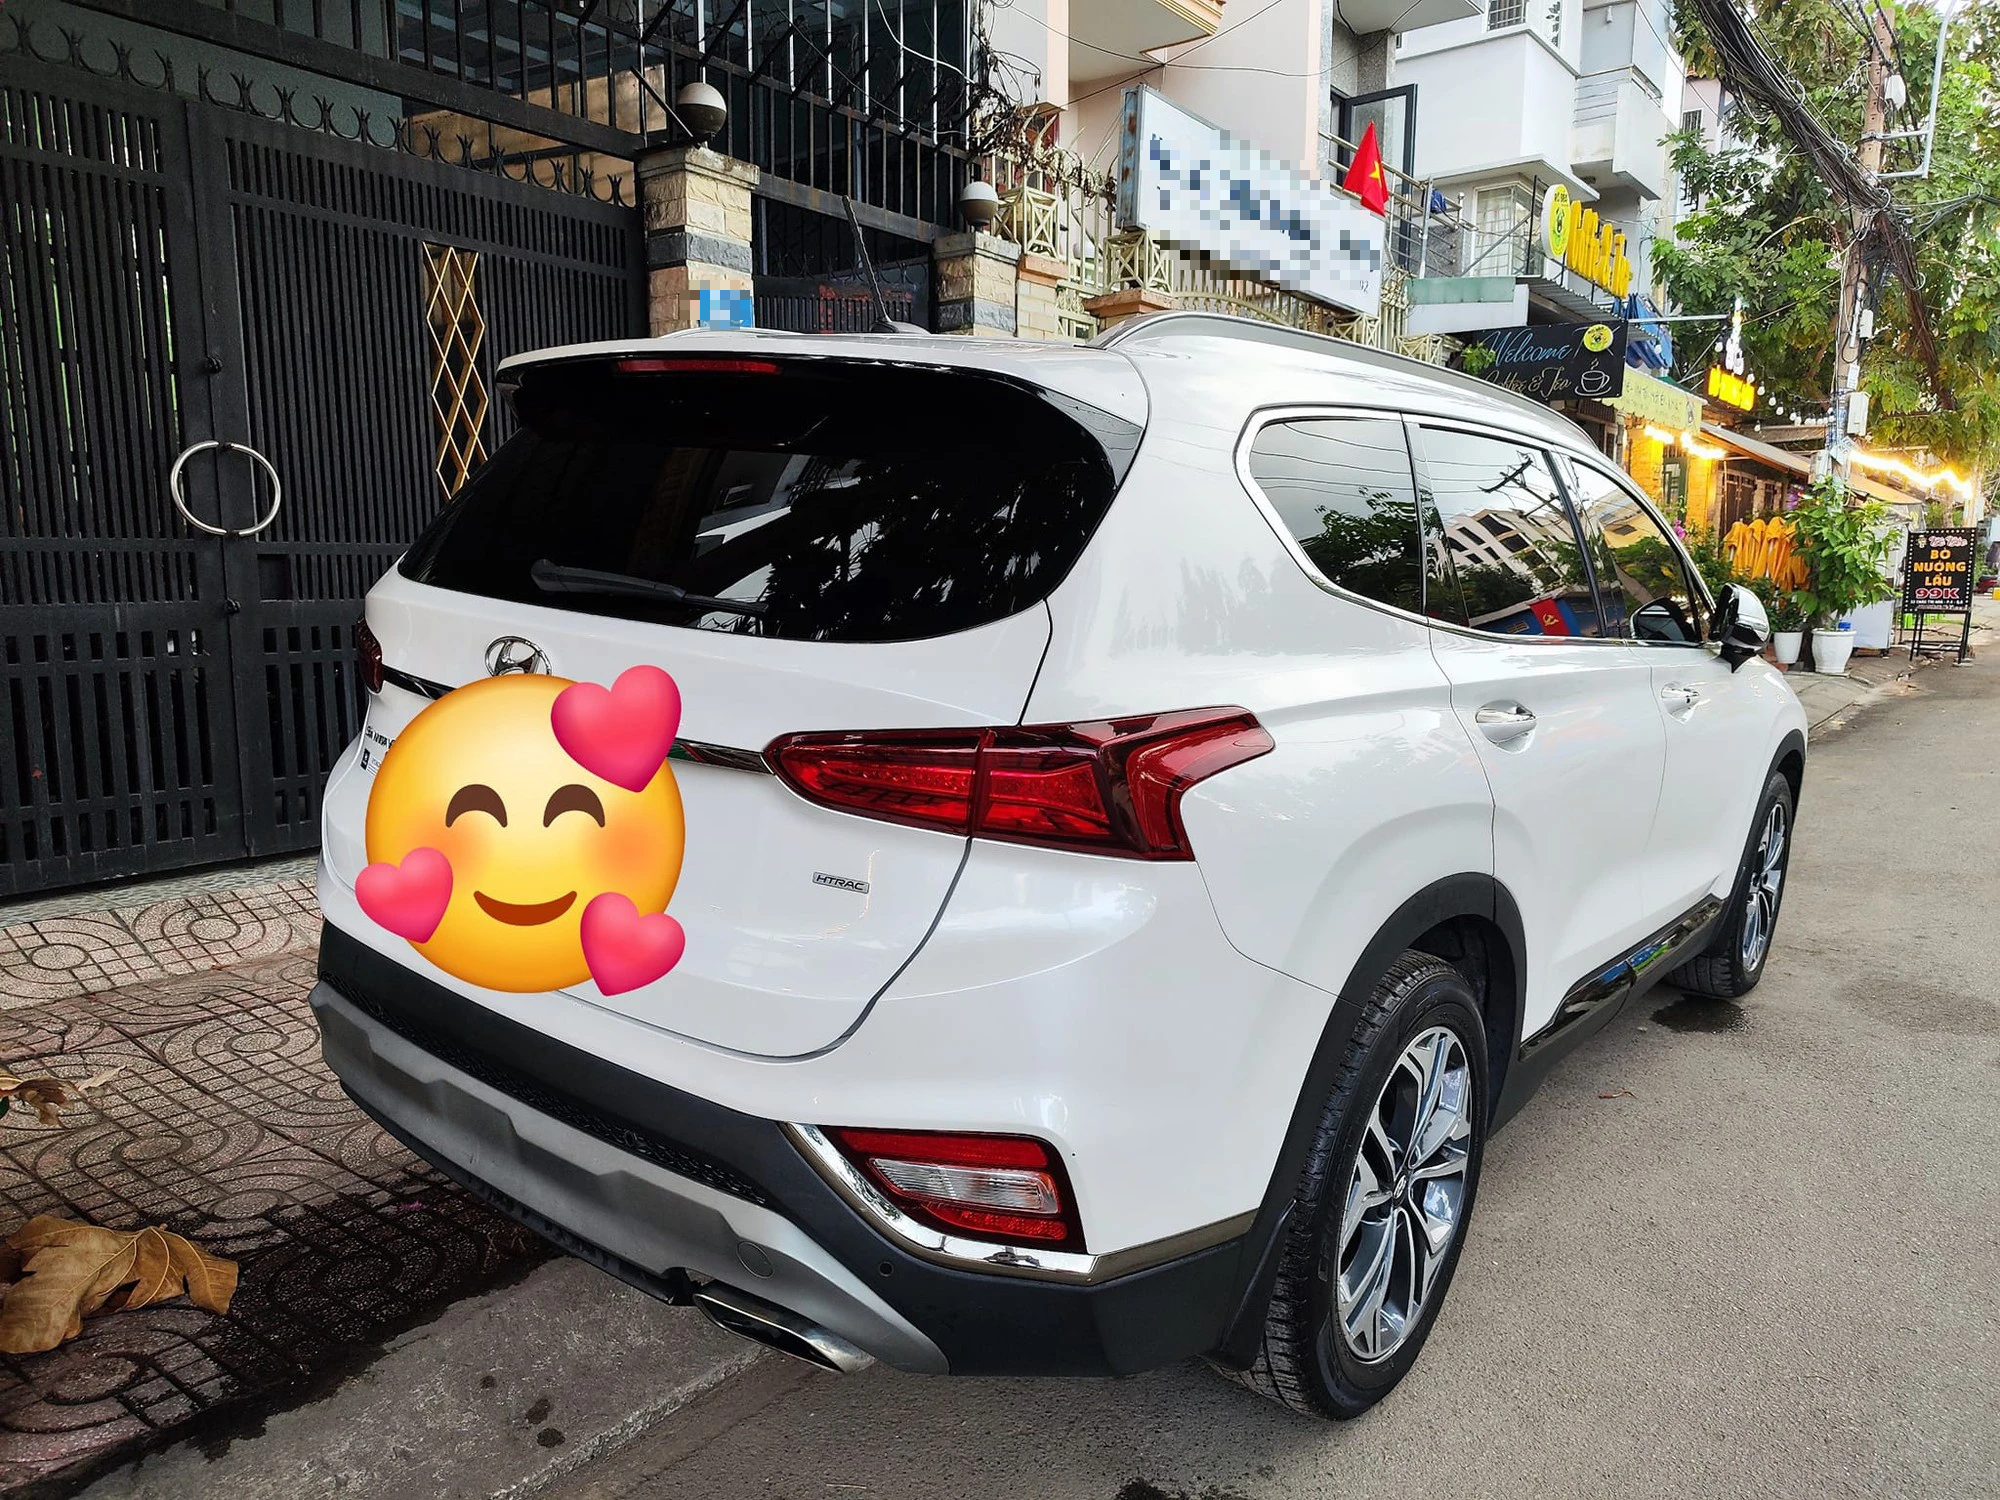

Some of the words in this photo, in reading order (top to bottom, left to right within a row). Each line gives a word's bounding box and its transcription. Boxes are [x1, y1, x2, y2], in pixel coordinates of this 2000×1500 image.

[1480, 328, 1572, 367] Welcome
[1528, 375, 1541, 393] &
[1540, 366, 1572, 398] Tea
[1915, 588, 1960, 599] 99K
[816, 874, 865, 891] HTRAC
